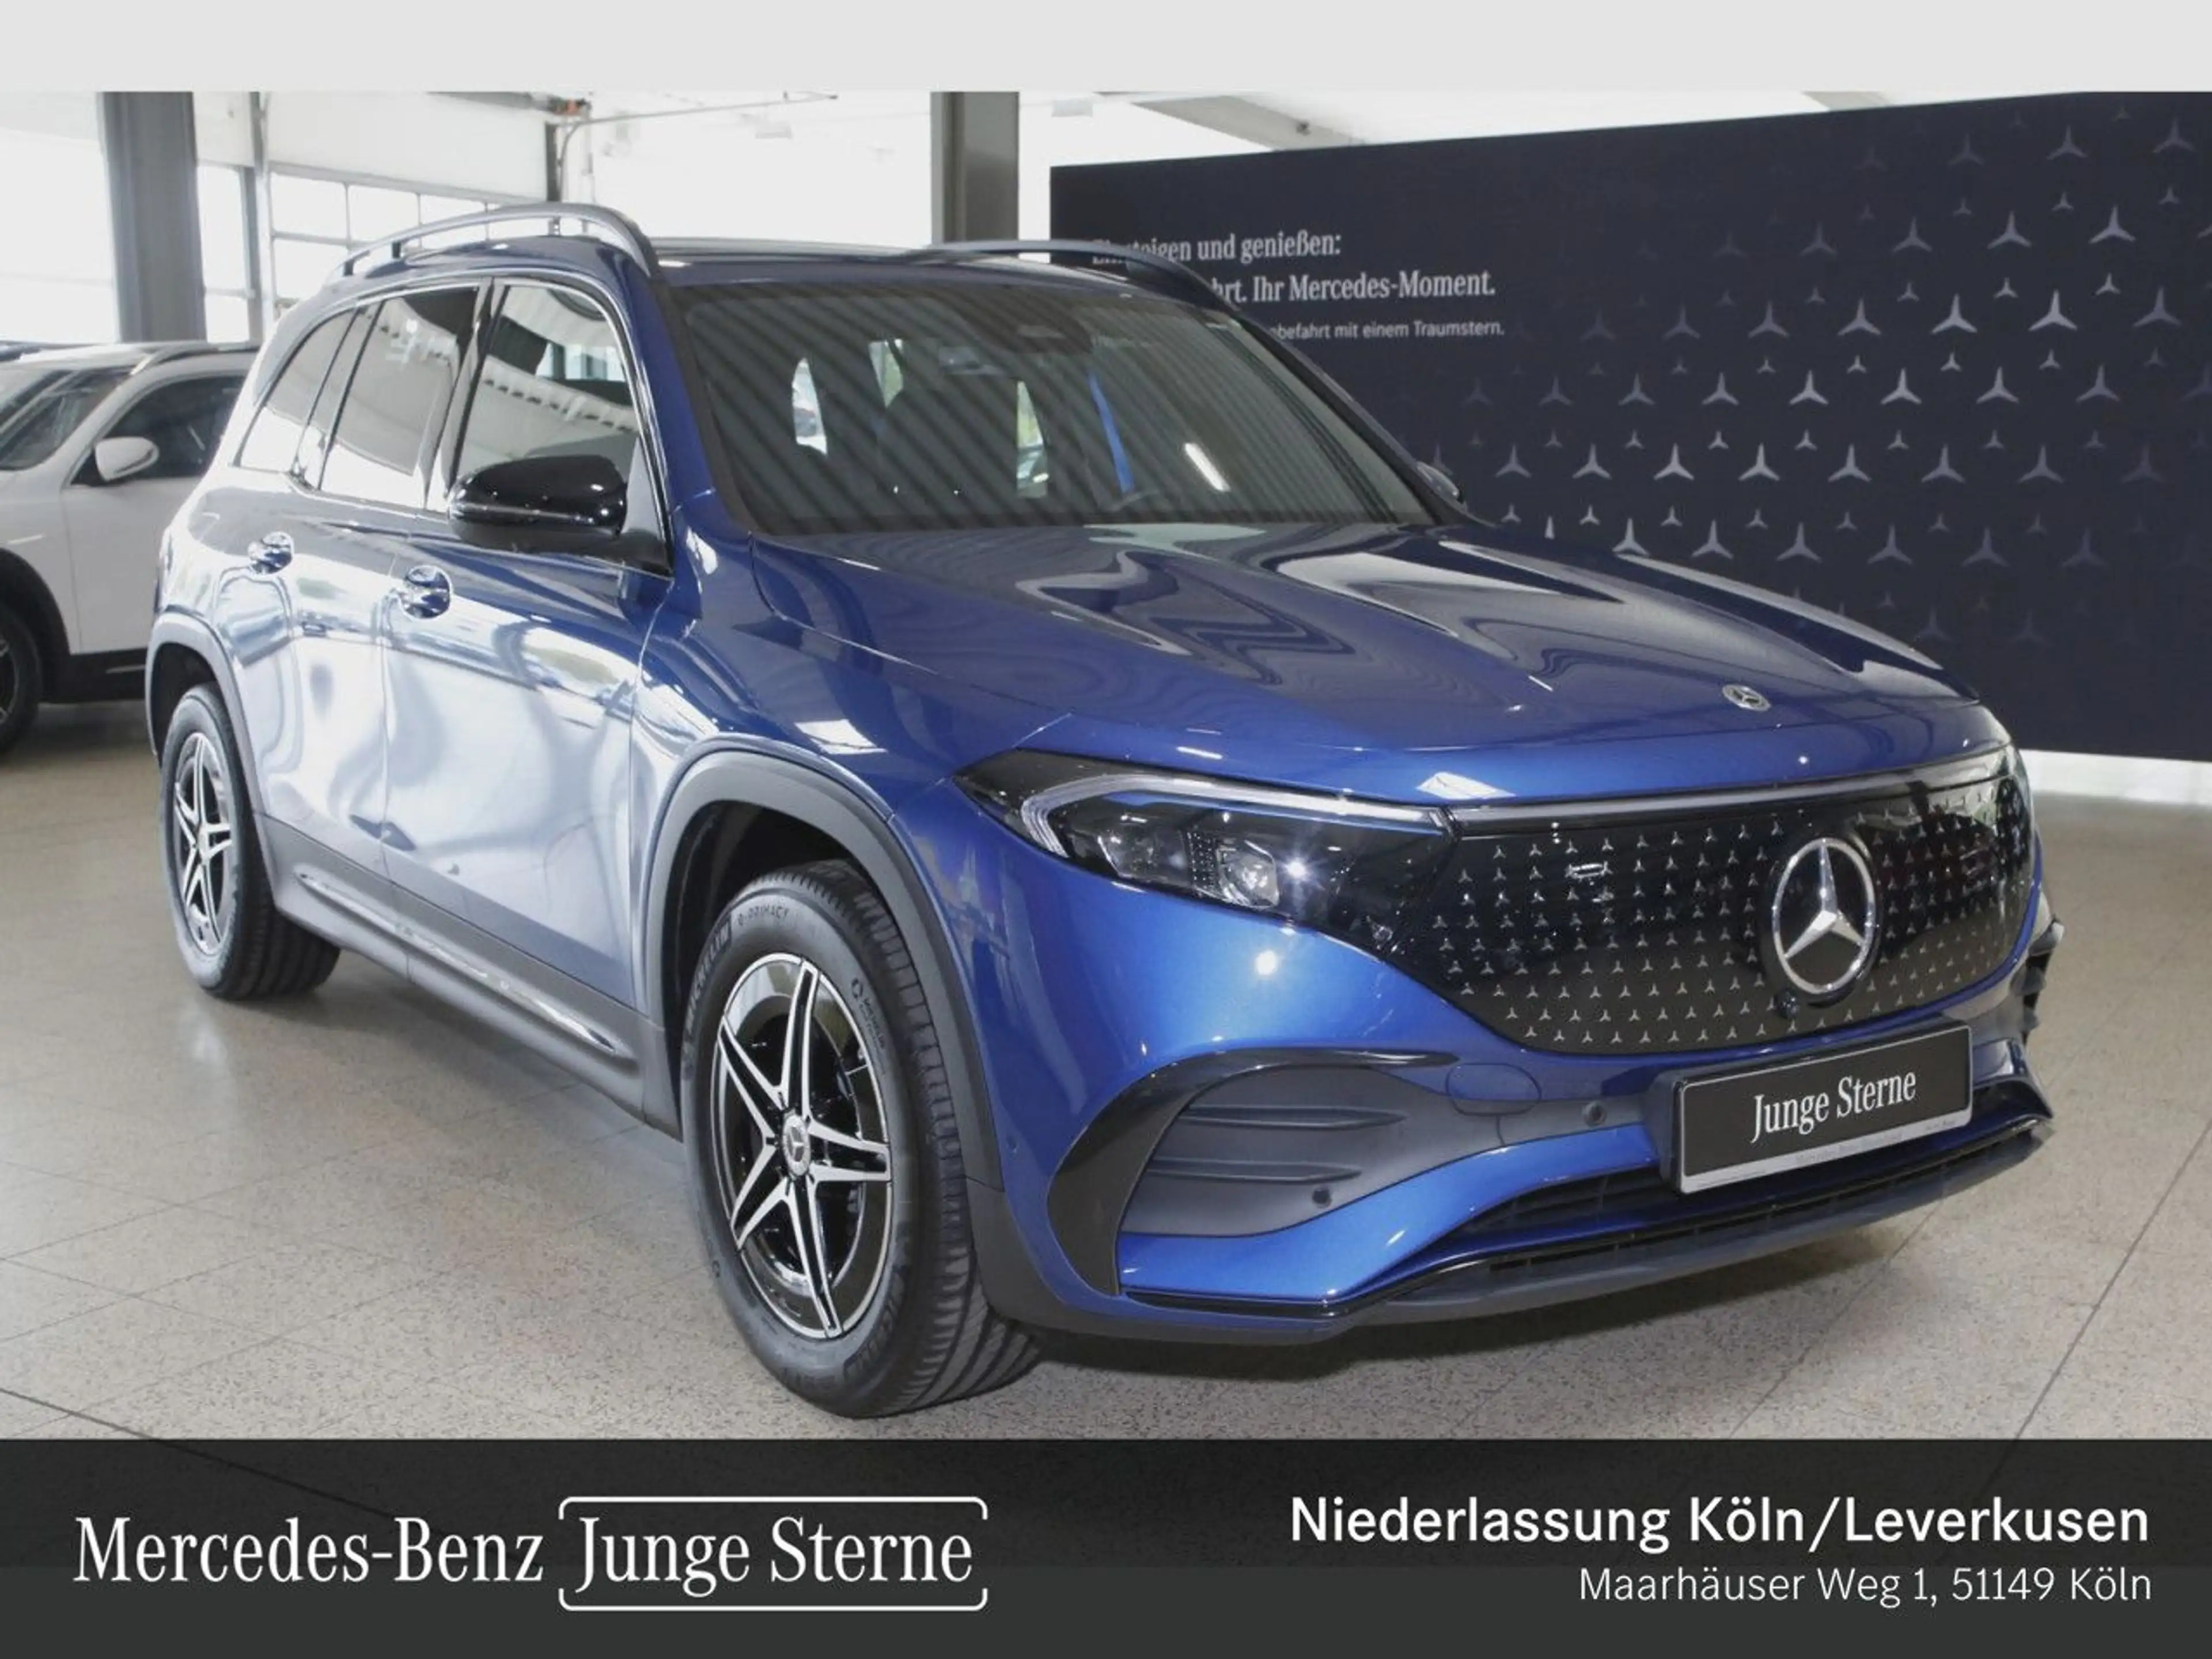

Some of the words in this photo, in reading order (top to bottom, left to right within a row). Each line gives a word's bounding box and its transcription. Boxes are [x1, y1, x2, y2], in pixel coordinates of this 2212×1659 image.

[1198, 233, 1236, 260] und
[1241, 229, 1341, 264] genießen:
[1253, 275, 1285, 302] Ihr
[1289, 270, 1496, 301] Mercedes-Moment.
[1334, 321, 1358, 339] mit
[1362, 320, 1410, 338] einem
[1414, 320, 1505, 338] Traumstern.
[1751, 1092, 1830, 1144] Junge
[1836, 1071, 1916, 1119] Sterne
